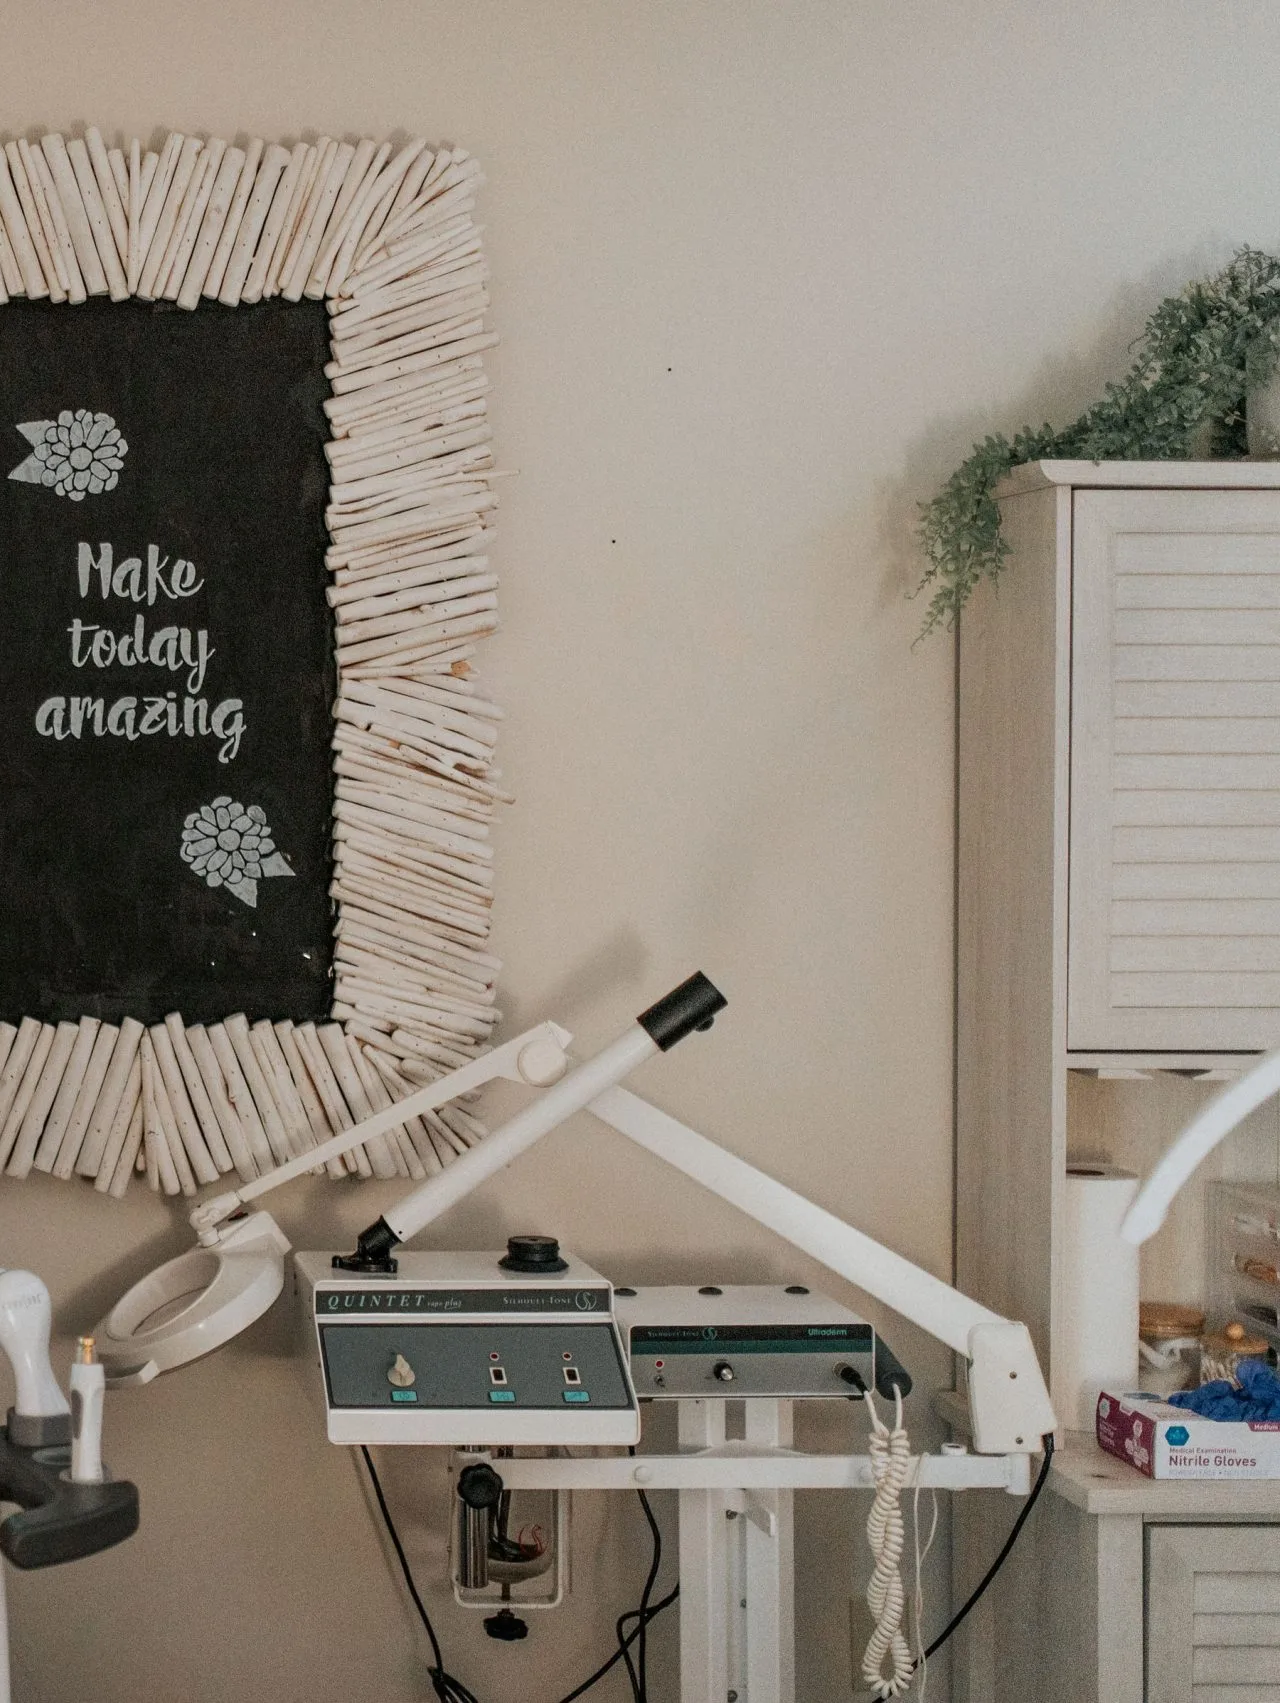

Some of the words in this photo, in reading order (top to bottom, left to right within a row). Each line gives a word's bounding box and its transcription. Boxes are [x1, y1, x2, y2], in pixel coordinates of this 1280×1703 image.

[77, 542, 205, 606] Make
[67, 614, 216, 694] today
[35, 692, 247, 764] amazing
[327, 1295, 425, 1310] QUINTET
[808, 1328, 847, 1336] Ultraderm
[1169, 1456, 1210, 1467] Nitrile
[1214, 1456, 1257, 1467] Gloves
